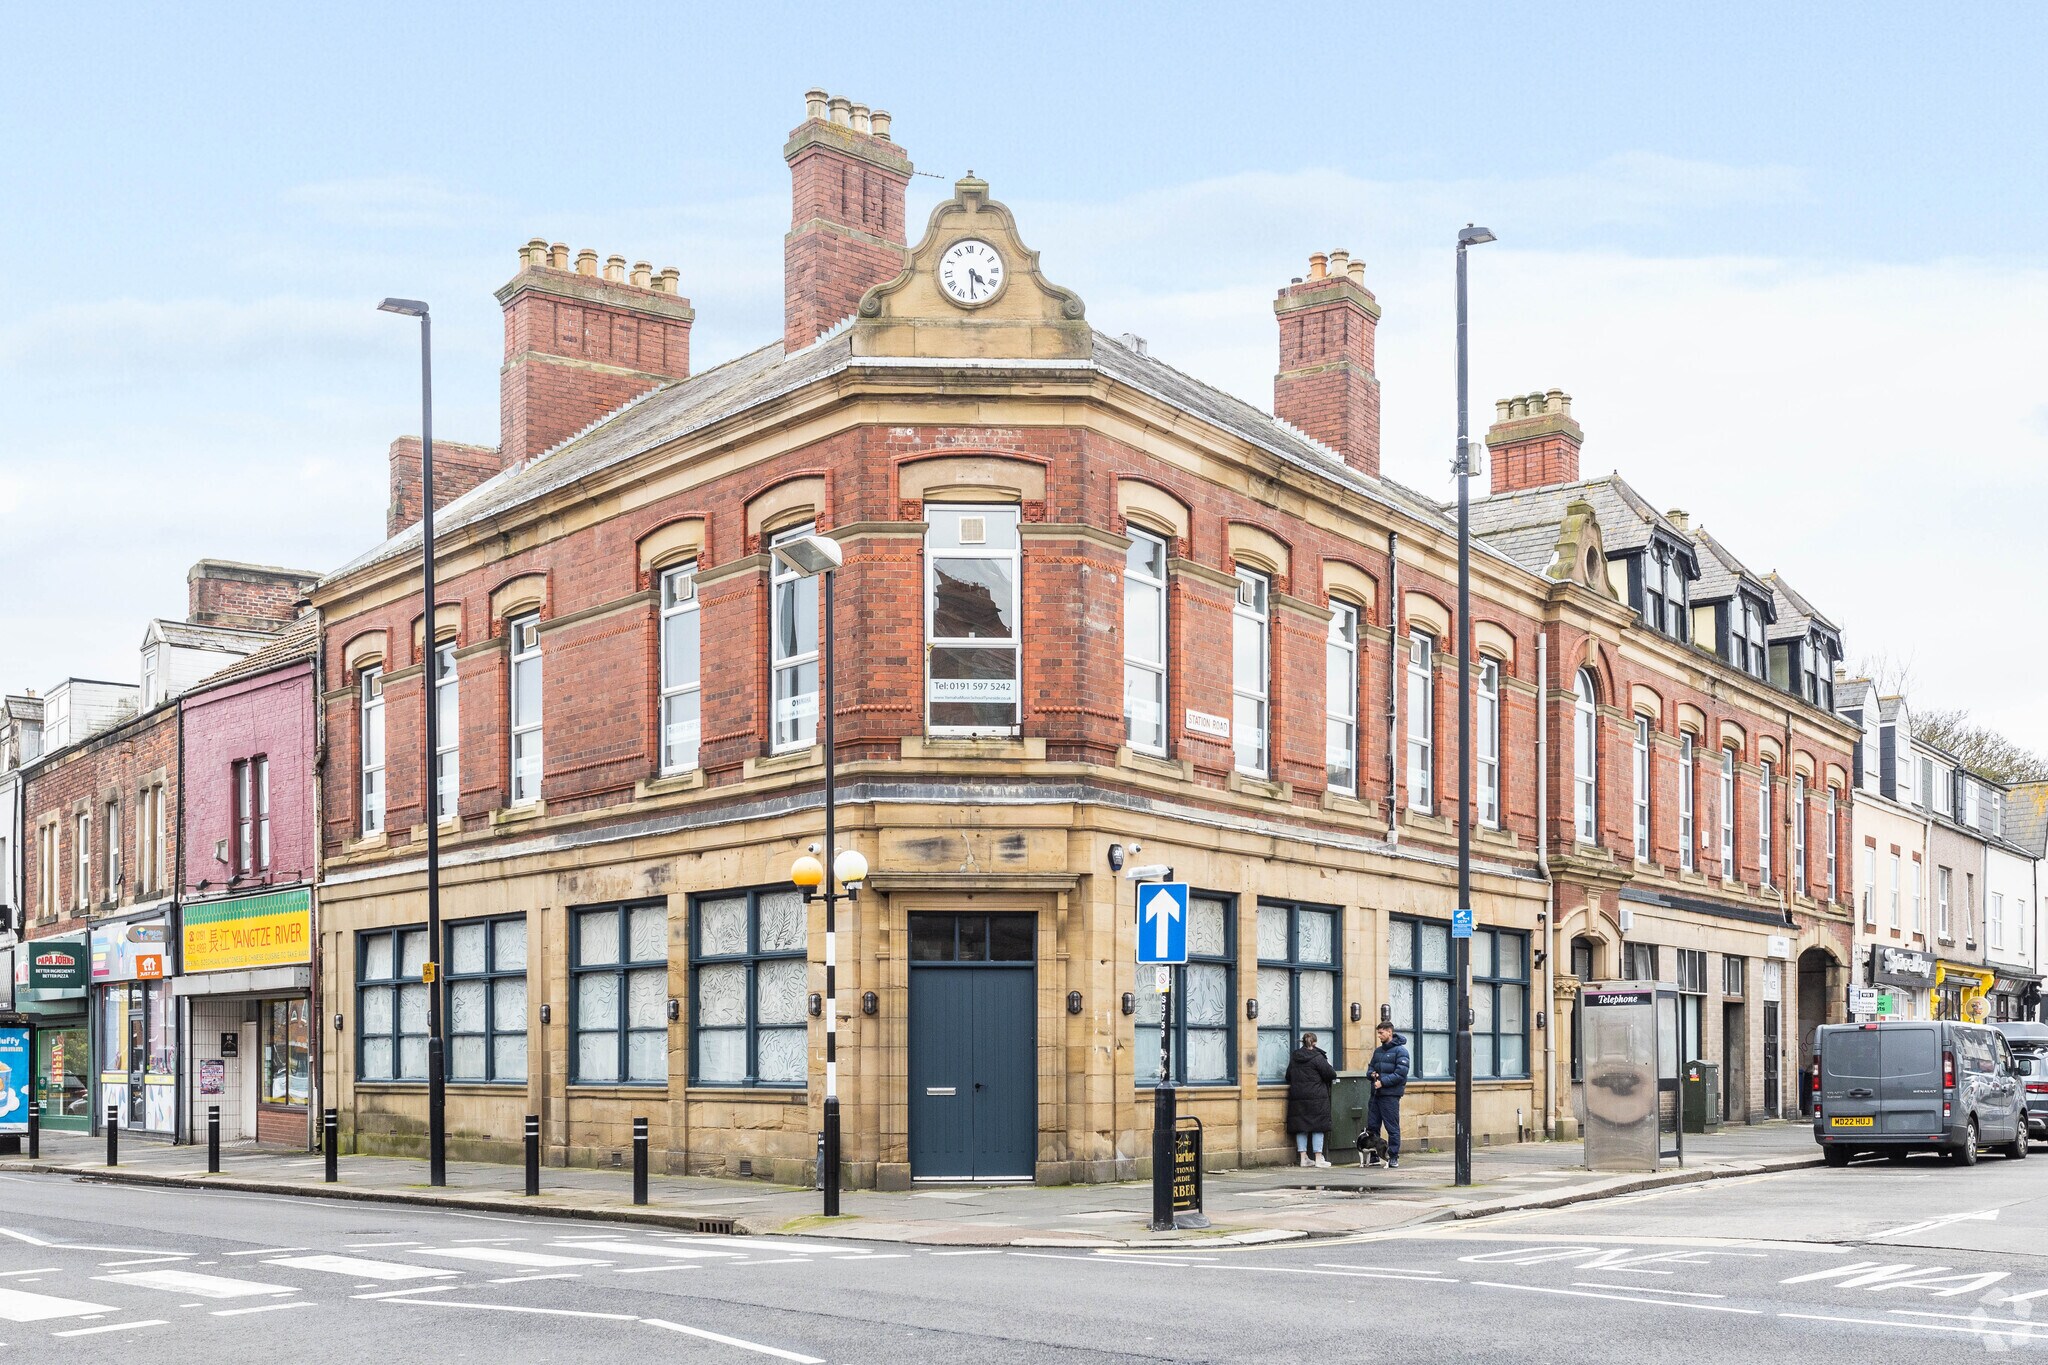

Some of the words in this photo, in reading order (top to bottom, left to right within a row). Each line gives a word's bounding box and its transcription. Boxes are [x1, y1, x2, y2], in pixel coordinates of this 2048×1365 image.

[972, 682, 988, 690] 597
[990, 682, 1011, 690] 5242
[1188, 714, 1210, 728] STATION
[1212, 720, 1228, 732] ROAD
[209, 928, 230, 953] 長江
[231, 926, 271, 948] YANGTZE
[276, 922, 302, 944] RIVER
[38, 956, 53, 964] PAPA
[1598, 994, 1638, 1005] Telephone
[1457, 1246, 1768, 1275] ONE
